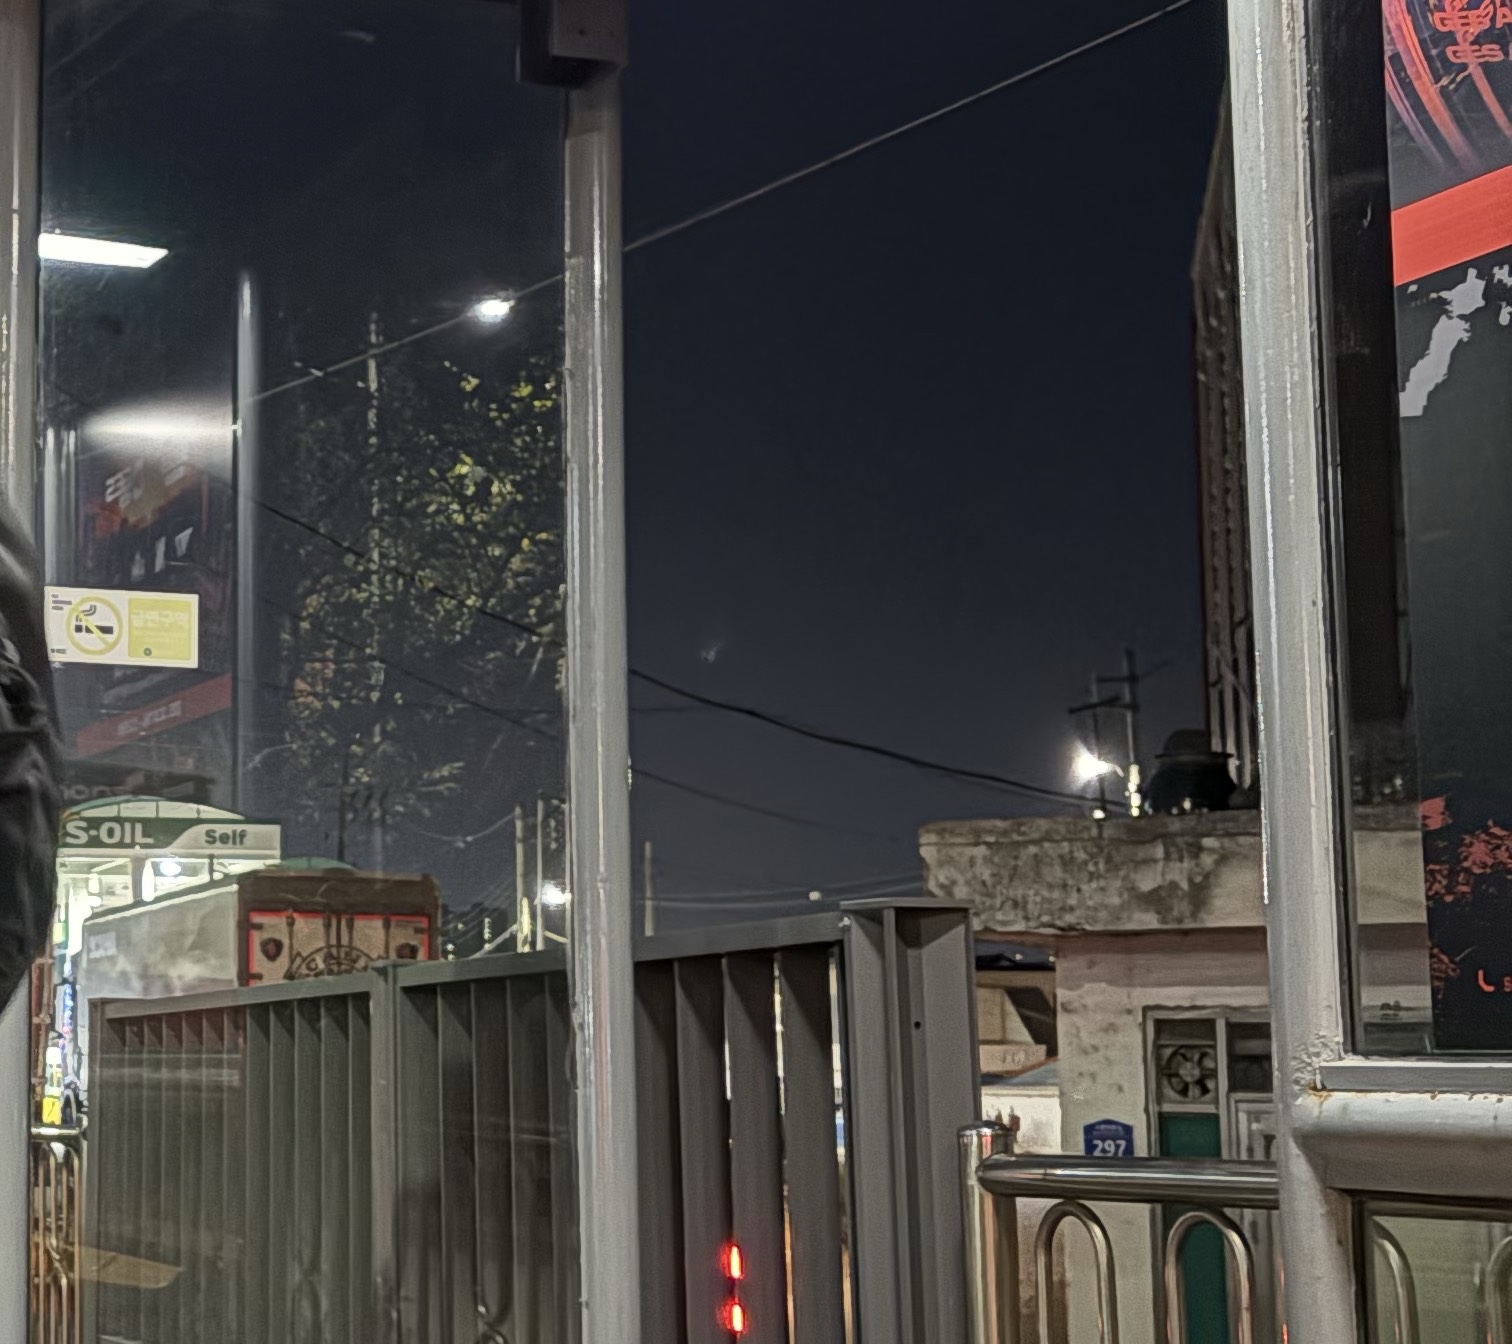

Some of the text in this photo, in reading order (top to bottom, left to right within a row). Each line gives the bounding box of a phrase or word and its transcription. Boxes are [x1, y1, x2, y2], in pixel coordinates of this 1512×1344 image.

[64, 819, 249, 846] S-OIL Self
[1092, 1139, 1127, 1157] 297
